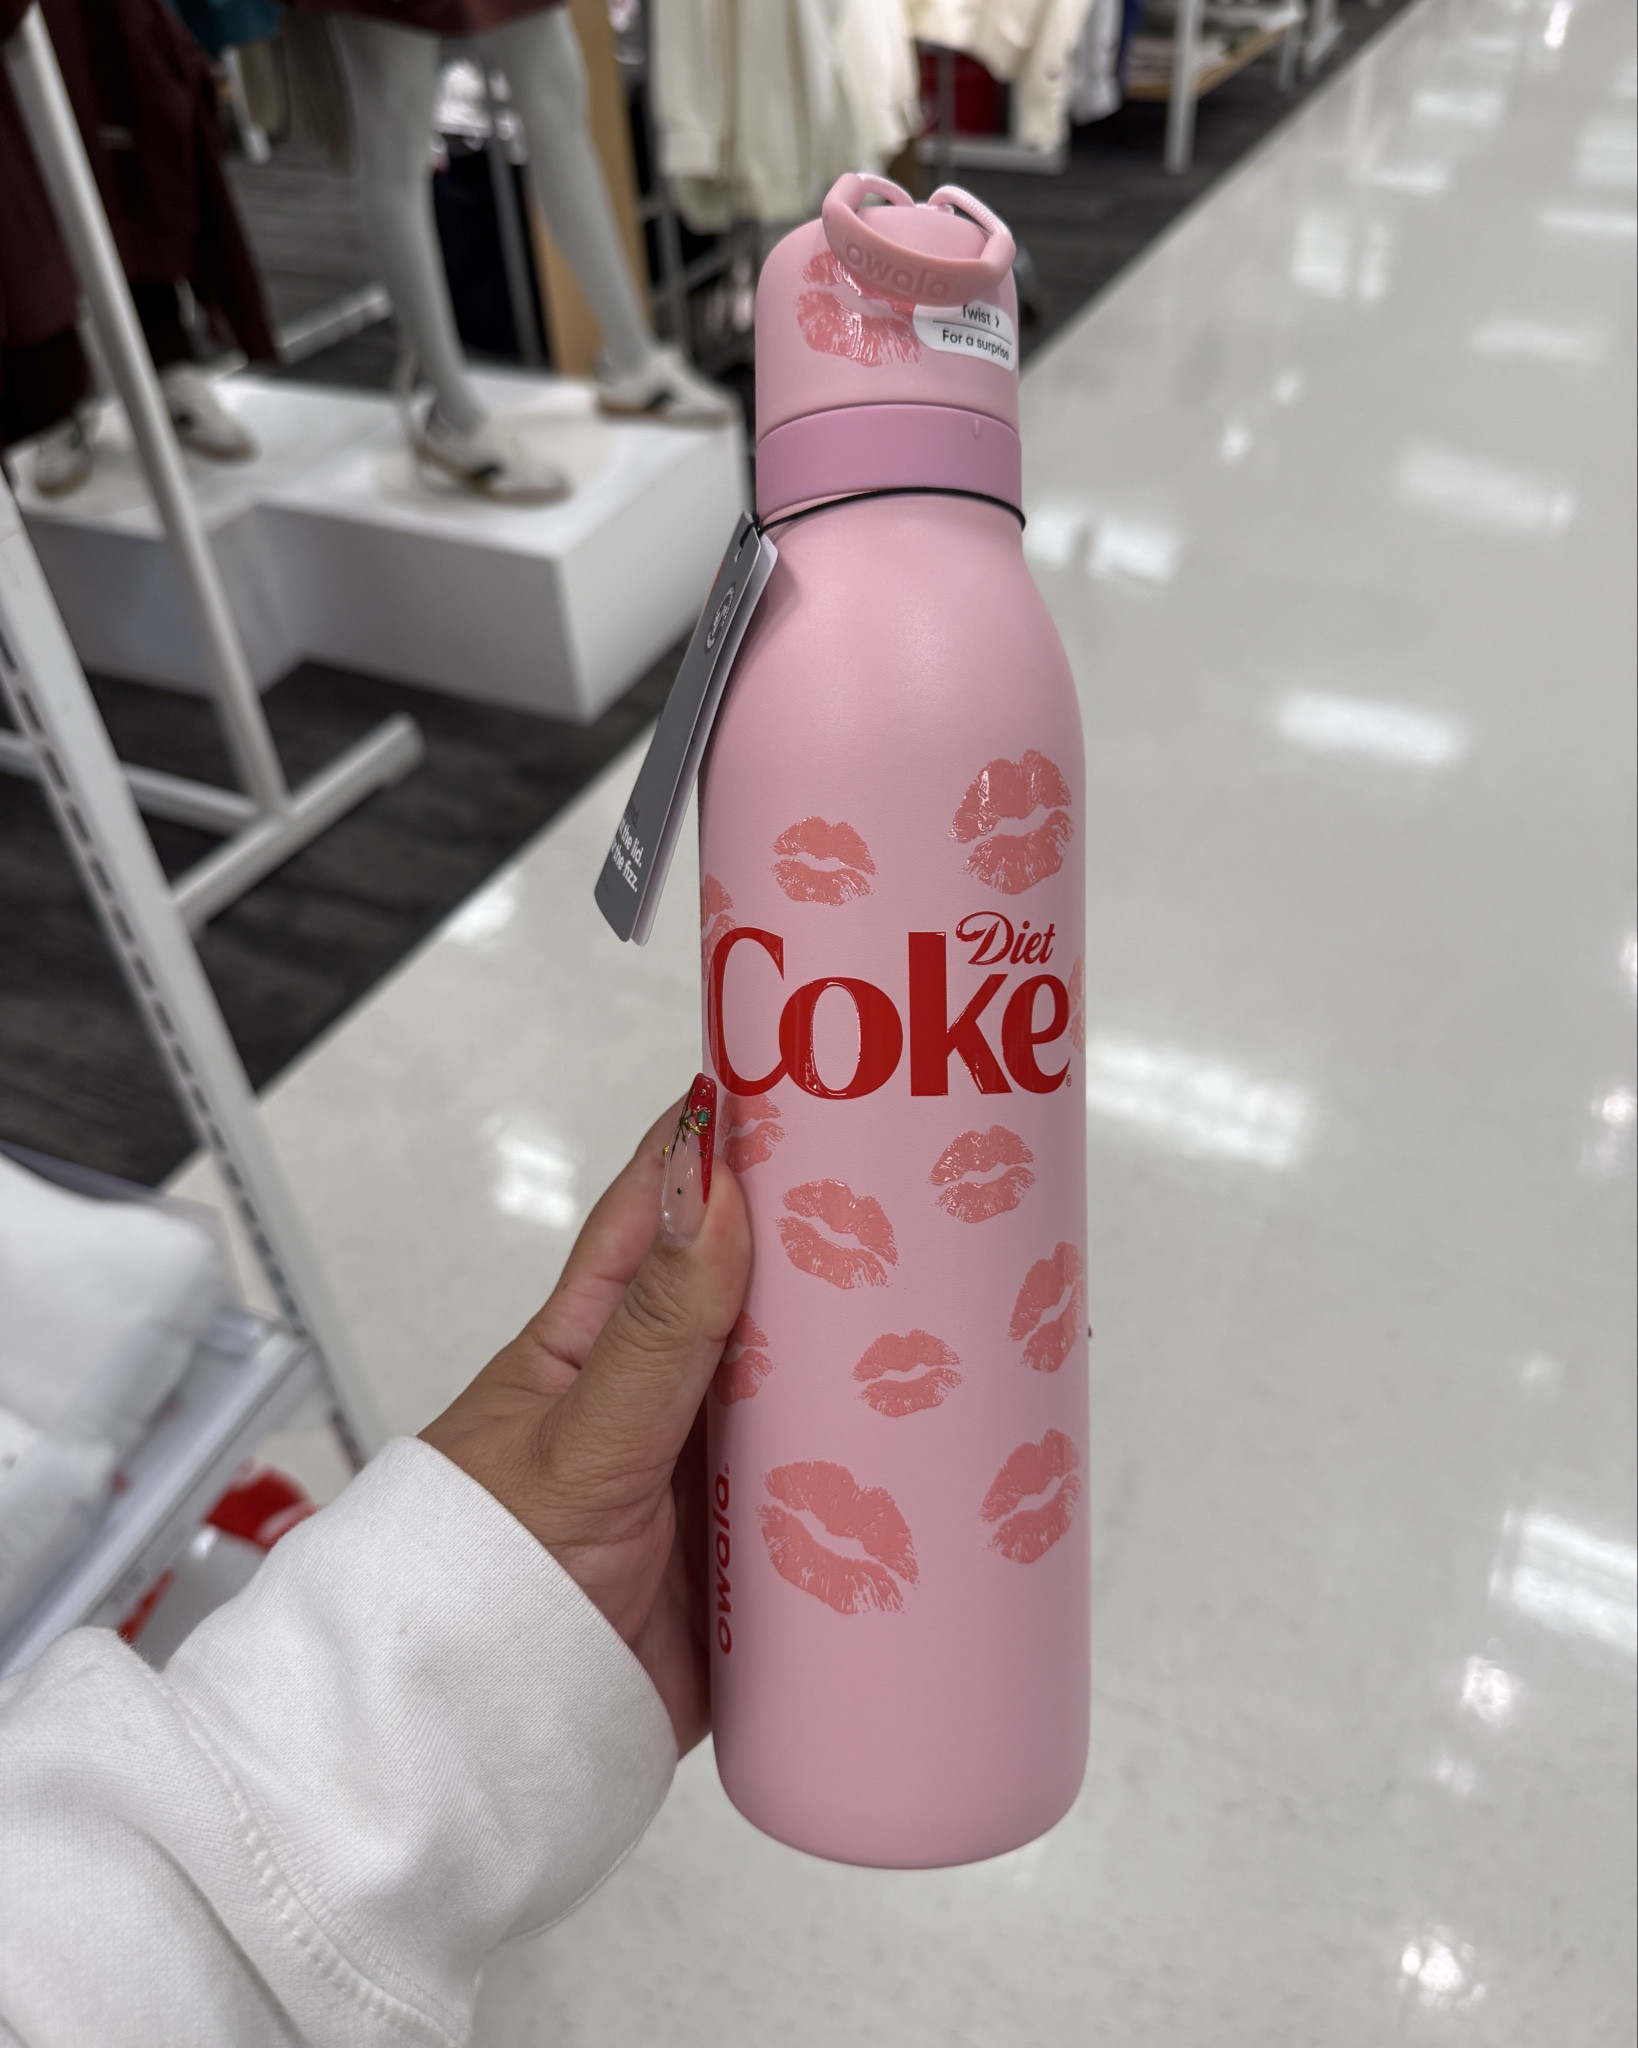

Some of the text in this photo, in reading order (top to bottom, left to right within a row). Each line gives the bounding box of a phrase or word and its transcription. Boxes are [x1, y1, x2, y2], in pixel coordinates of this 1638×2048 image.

[845, 243, 949, 298] owala
[942, 329, 1010, 361] For a surprise
[612, 844, 625, 871] the
[622, 859, 638, 893] fizz.
[621, 823, 633, 850] the
[630, 837, 644, 868] lid.
[955, 910, 1056, 966] Diet
[707, 926, 1071, 1100] Coke
[712, 1472, 733, 1655] owala
